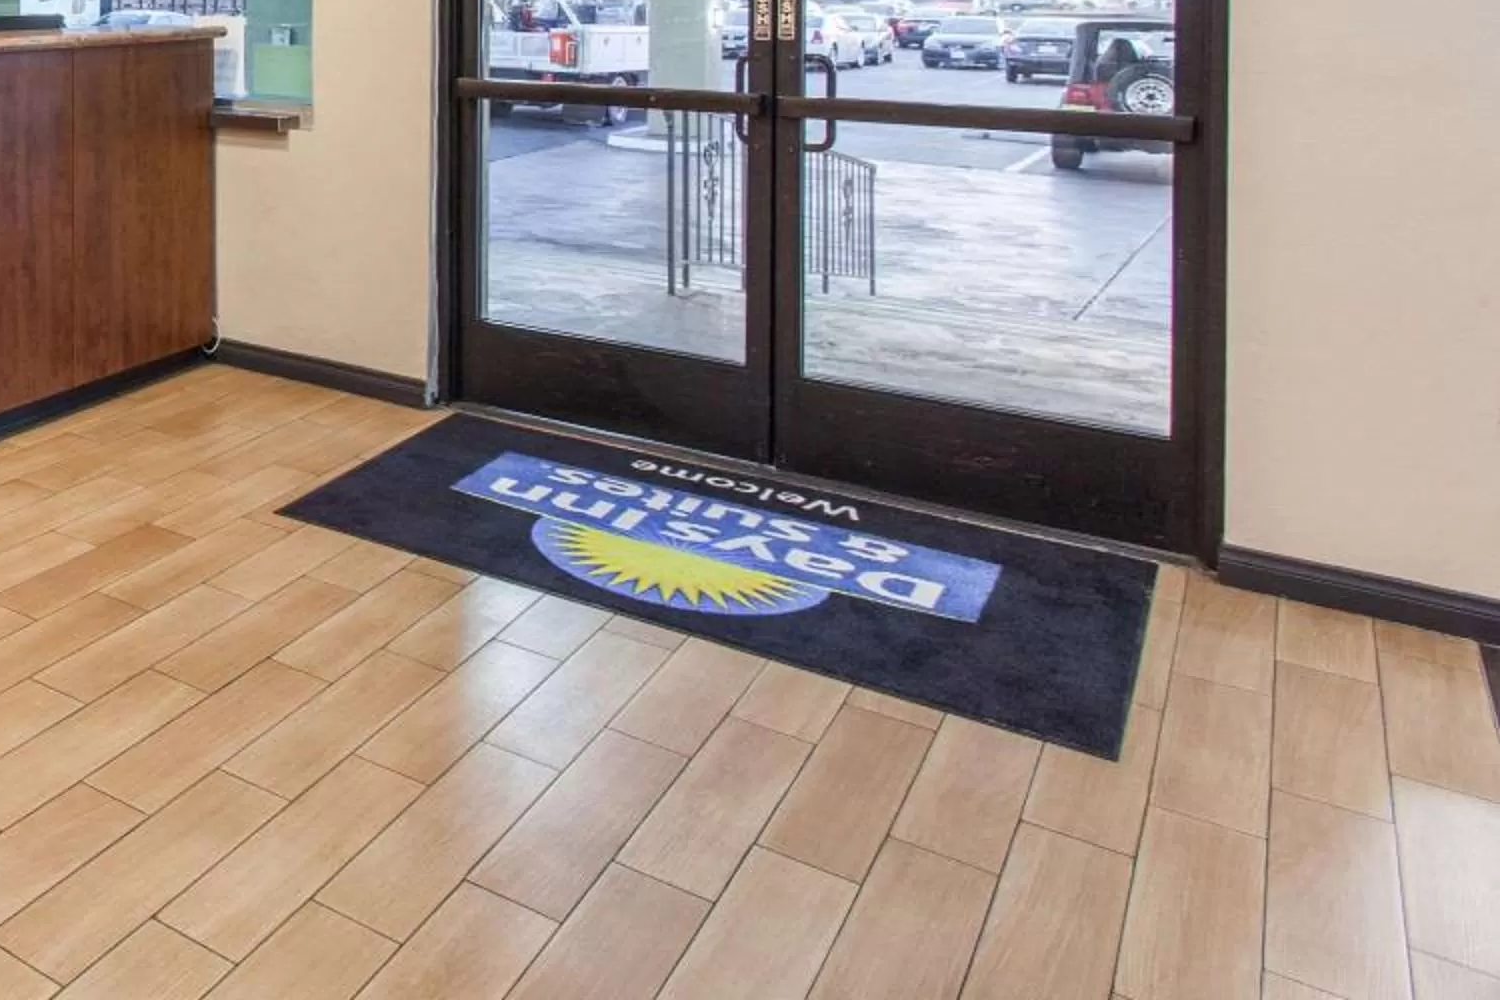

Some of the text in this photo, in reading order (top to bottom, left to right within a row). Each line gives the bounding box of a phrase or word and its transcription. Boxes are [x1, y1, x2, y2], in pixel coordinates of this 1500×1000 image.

[631, 459, 860, 521] Welcome
[490, 477, 946, 609] Days Inn
[839, 535, 909, 563] &
